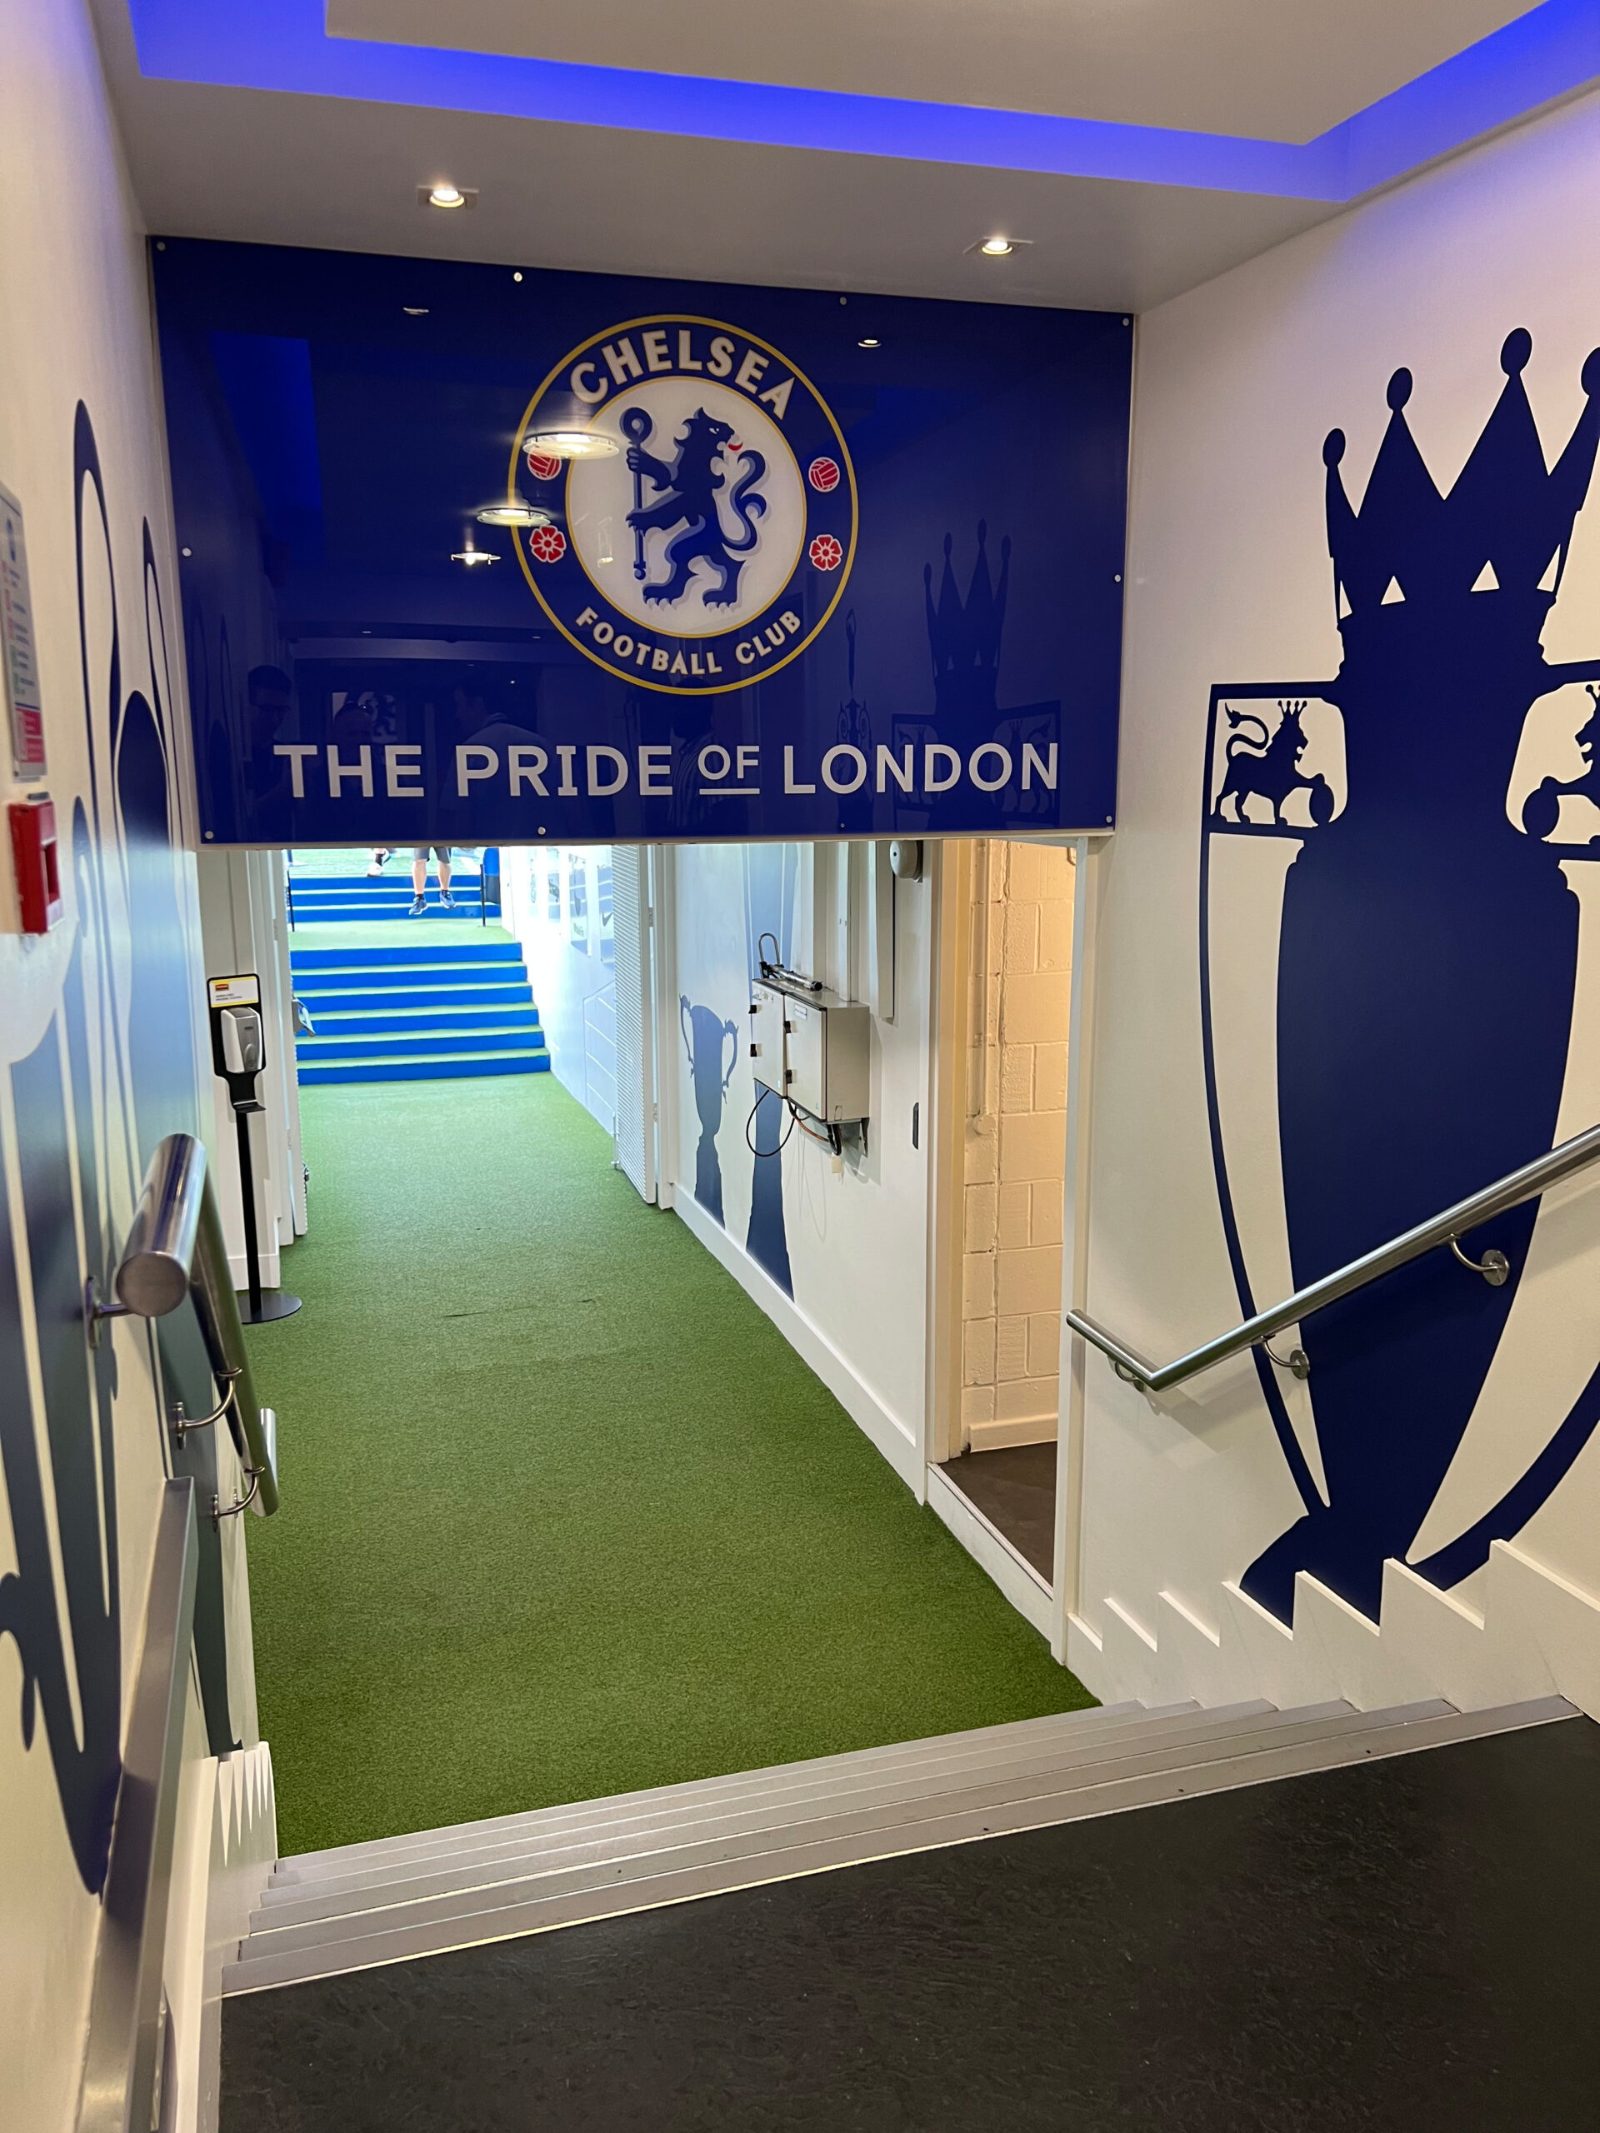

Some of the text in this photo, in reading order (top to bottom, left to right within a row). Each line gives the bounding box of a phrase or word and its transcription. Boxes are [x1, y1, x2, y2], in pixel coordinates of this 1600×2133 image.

[570, 329, 795, 420] CHELSEA
[576, 606, 801, 675] FOOTBALL CLUB
[273, 742, 1058, 798] THE PRIDE OF LONDON
